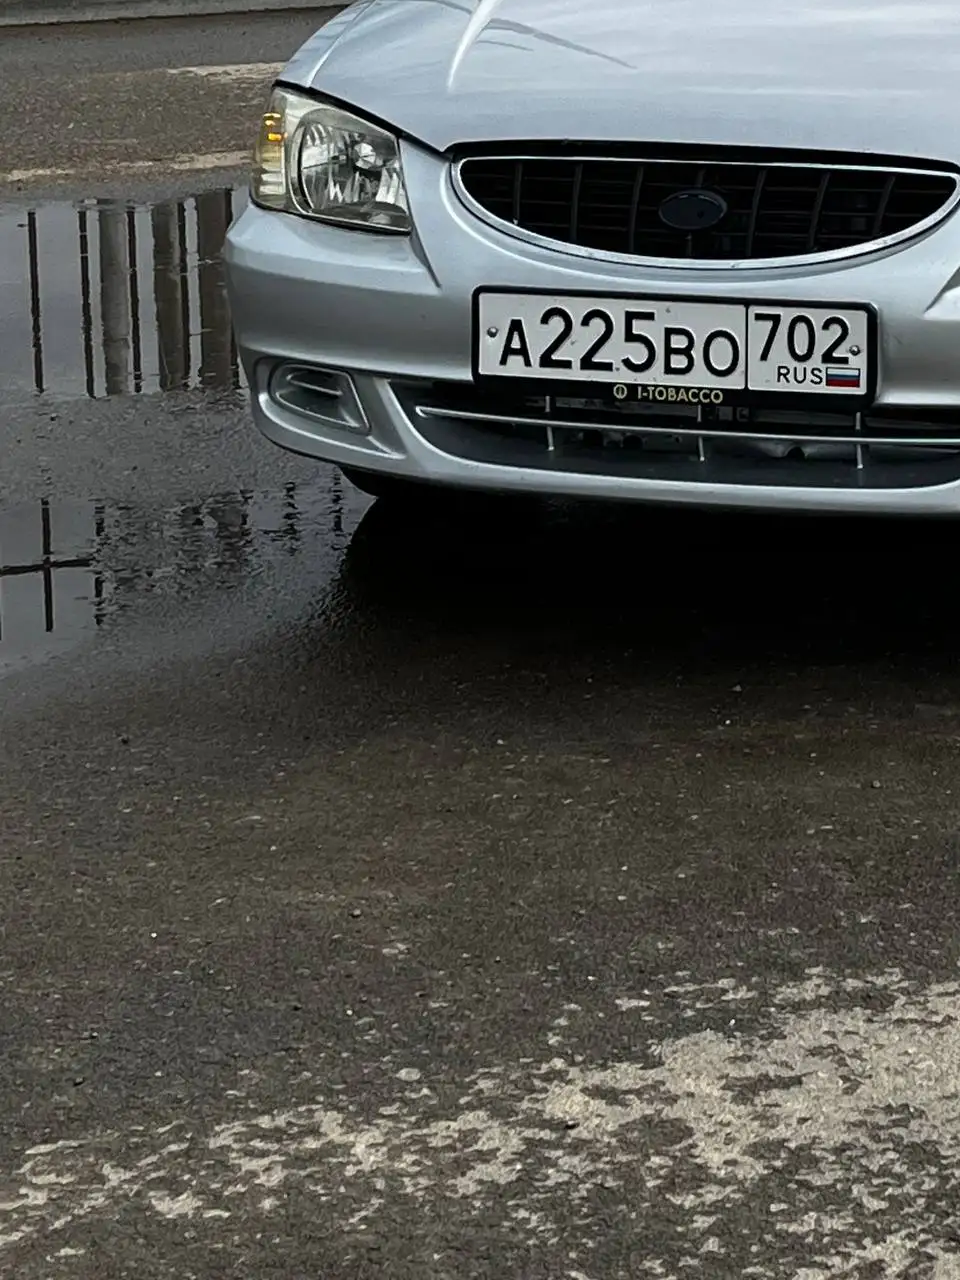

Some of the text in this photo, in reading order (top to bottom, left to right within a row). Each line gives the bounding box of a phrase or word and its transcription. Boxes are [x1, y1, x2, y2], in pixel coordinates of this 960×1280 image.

[754, 312, 850, 365] 702
[776, 365, 823, 385] RUS
[637, 385, 724, 404] I-TOBACCO
